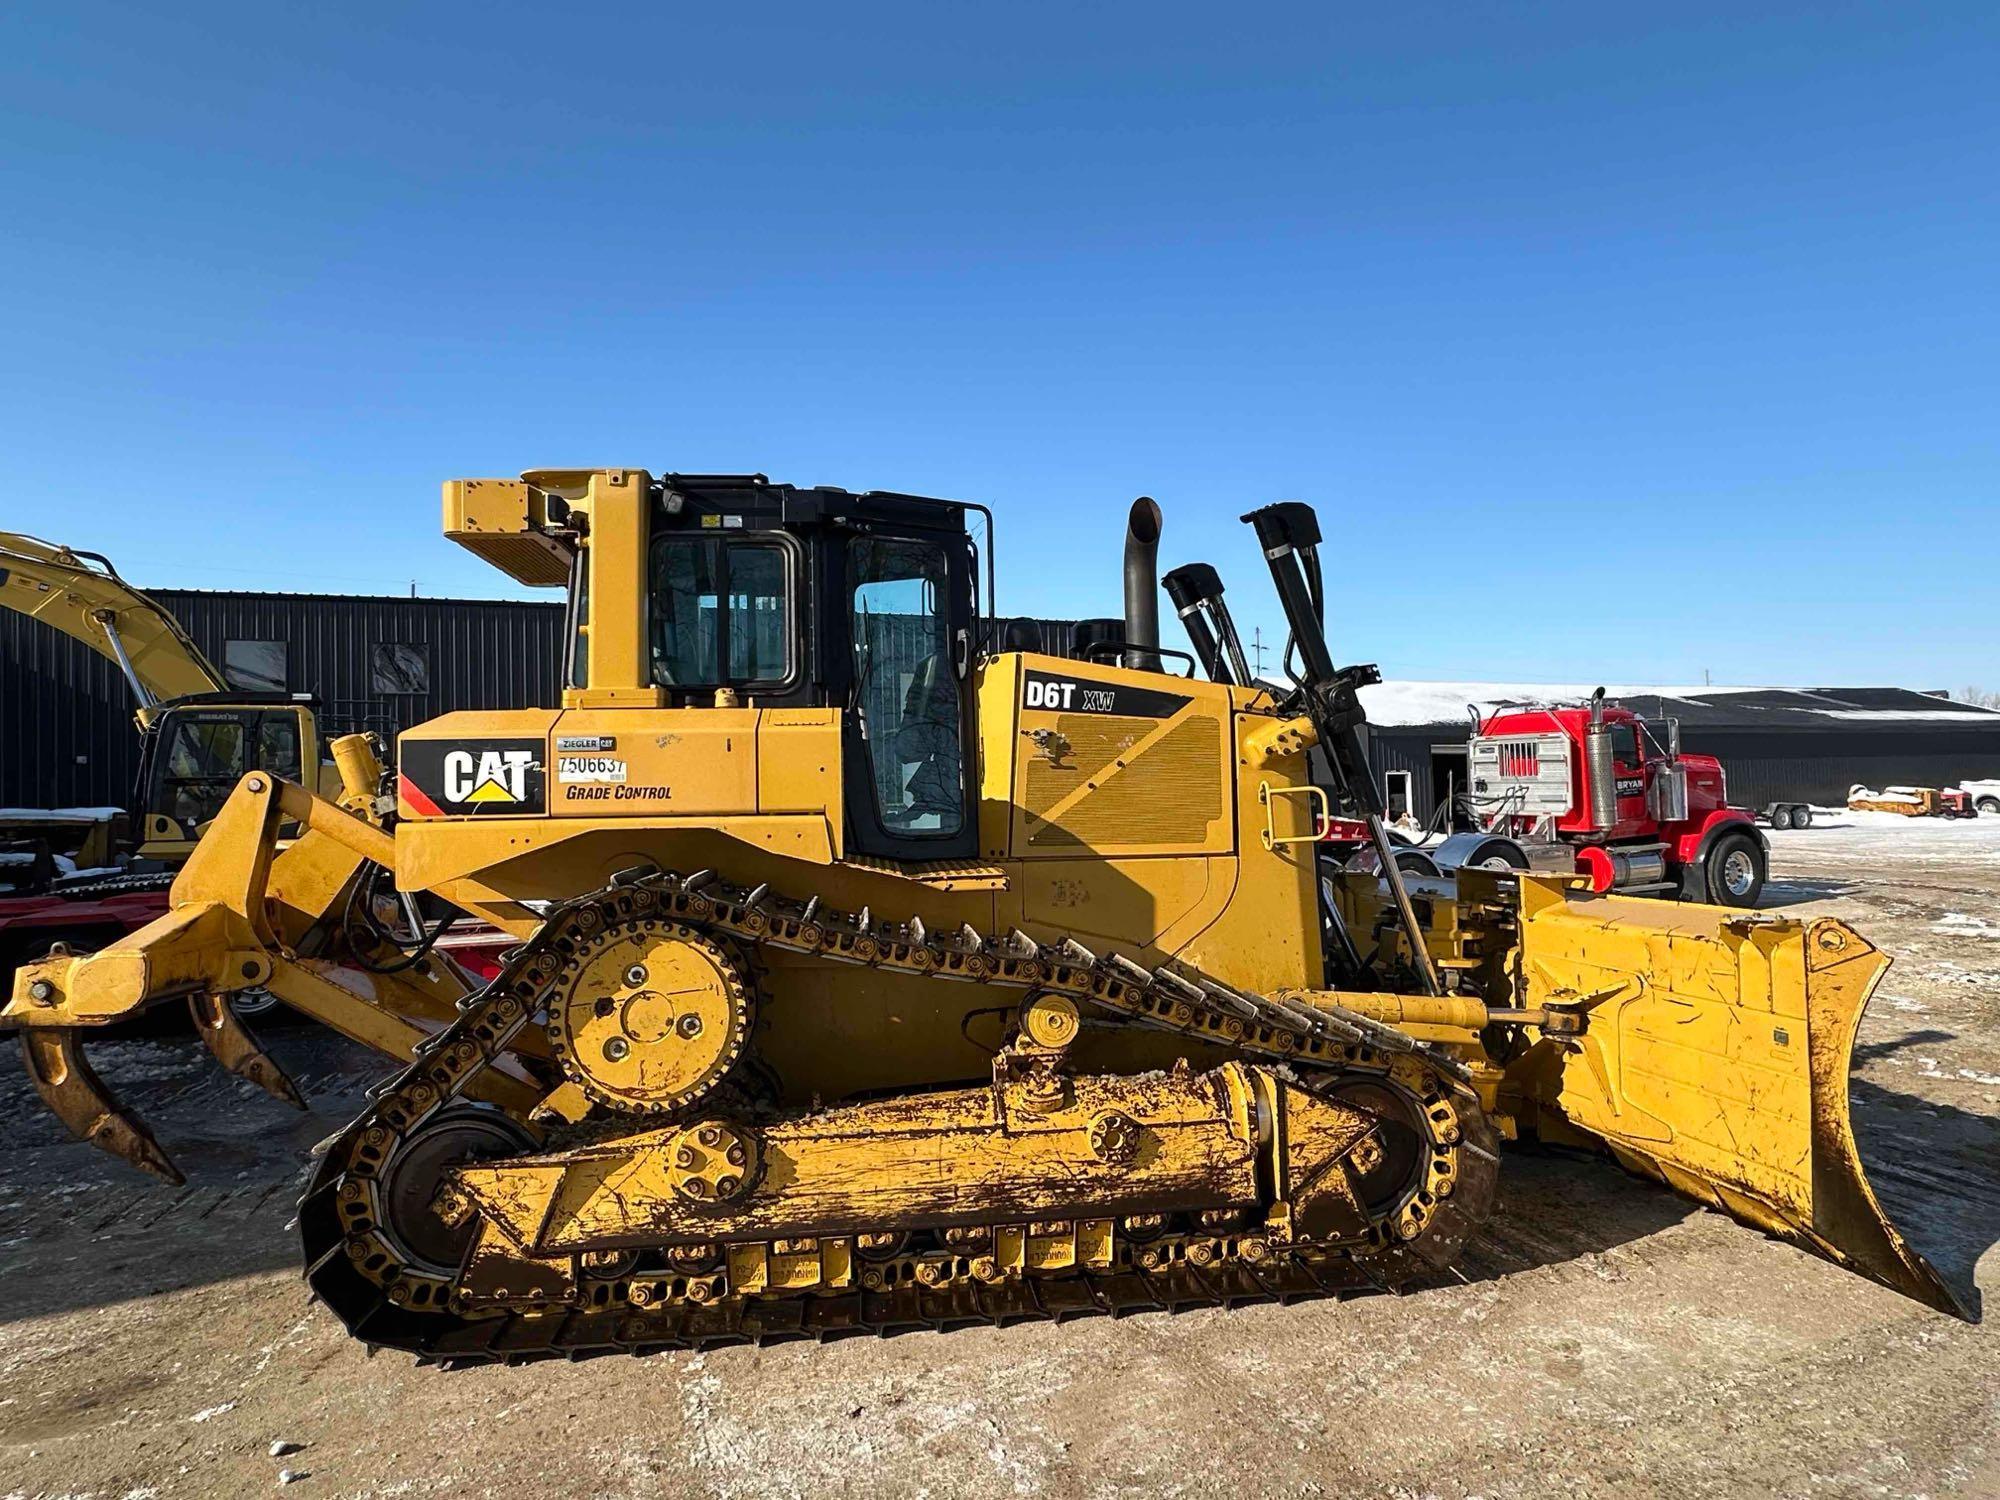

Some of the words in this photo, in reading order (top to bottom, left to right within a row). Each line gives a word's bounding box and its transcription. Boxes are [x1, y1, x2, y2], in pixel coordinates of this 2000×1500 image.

[1026, 680, 1076, 709] D6T
[1082, 690, 1115, 712] XW
[563, 740, 597, 748] ZIEGLER
[559, 758, 623, 773] 7506637
[443, 750, 533, 803] CAT
[566, 785, 611, 800] GRADE
[614, 785, 672, 800] CONTROL
[1616, 780, 1643, 790] BRYAN
